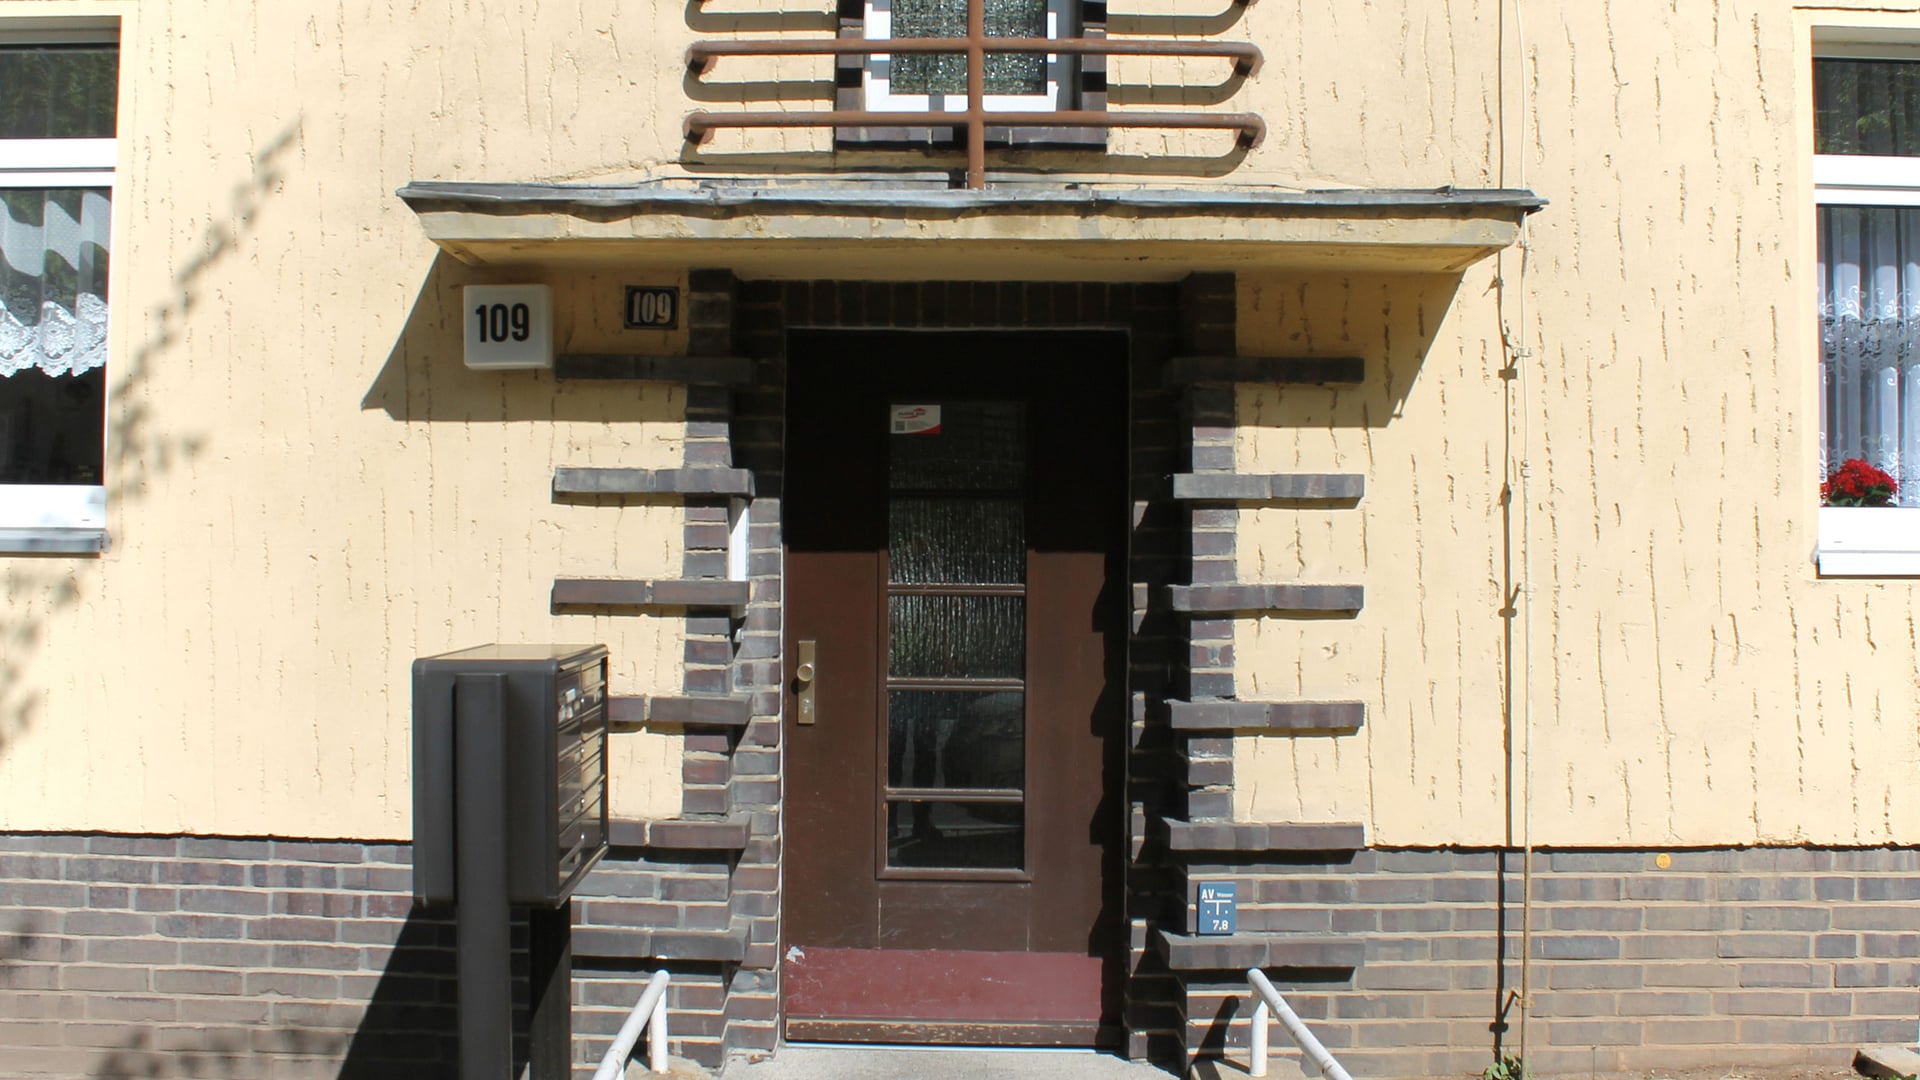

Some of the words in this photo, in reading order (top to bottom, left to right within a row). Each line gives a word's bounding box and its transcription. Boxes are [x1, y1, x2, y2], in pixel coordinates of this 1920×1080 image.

[475, 303, 530, 343] 109
[632, 291, 672, 325] 109
[1201, 888, 1215, 900] AV
